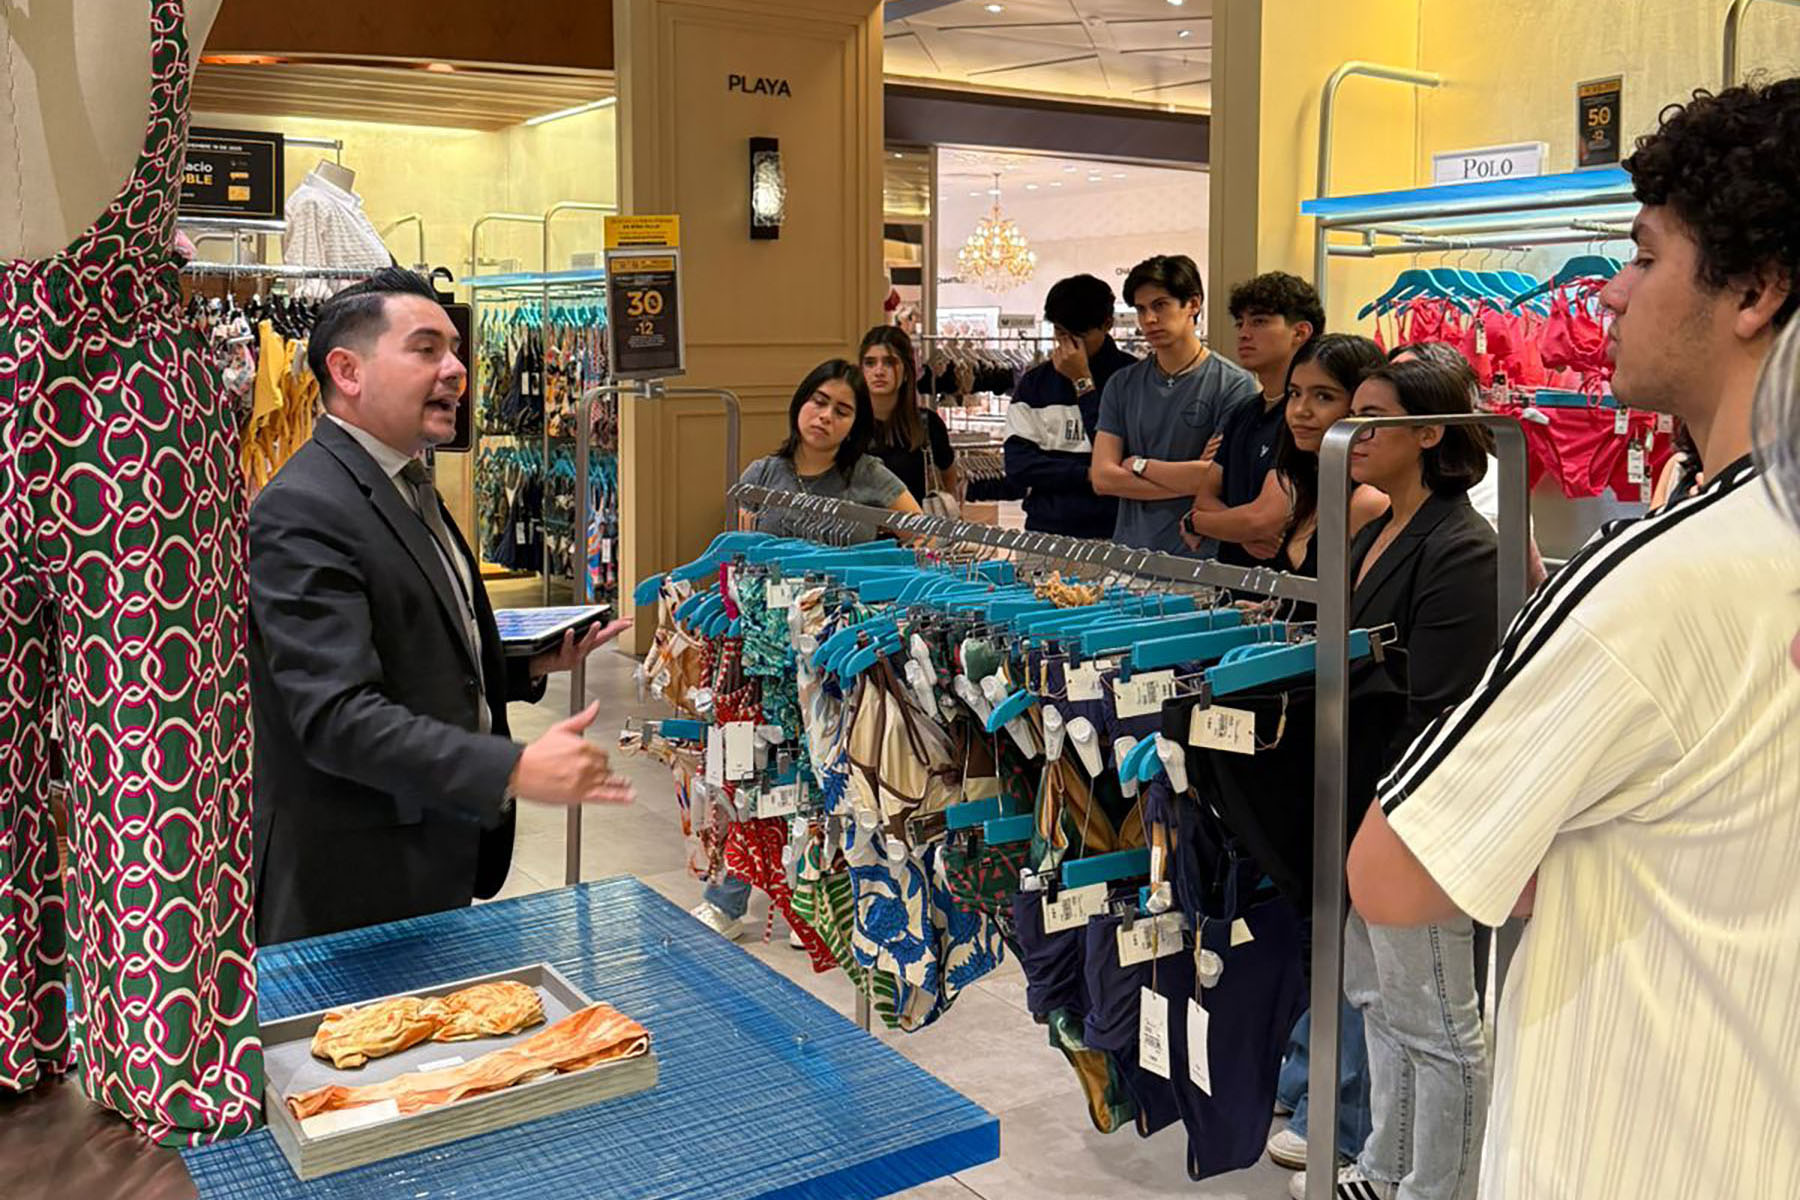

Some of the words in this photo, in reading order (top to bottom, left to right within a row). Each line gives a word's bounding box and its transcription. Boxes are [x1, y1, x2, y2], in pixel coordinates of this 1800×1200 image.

[728, 74, 792, 98] PLAYA
[1588, 106, 1611, 126] 50
[185, 161, 213, 173] acio
[627, 291, 663, 316] 30
